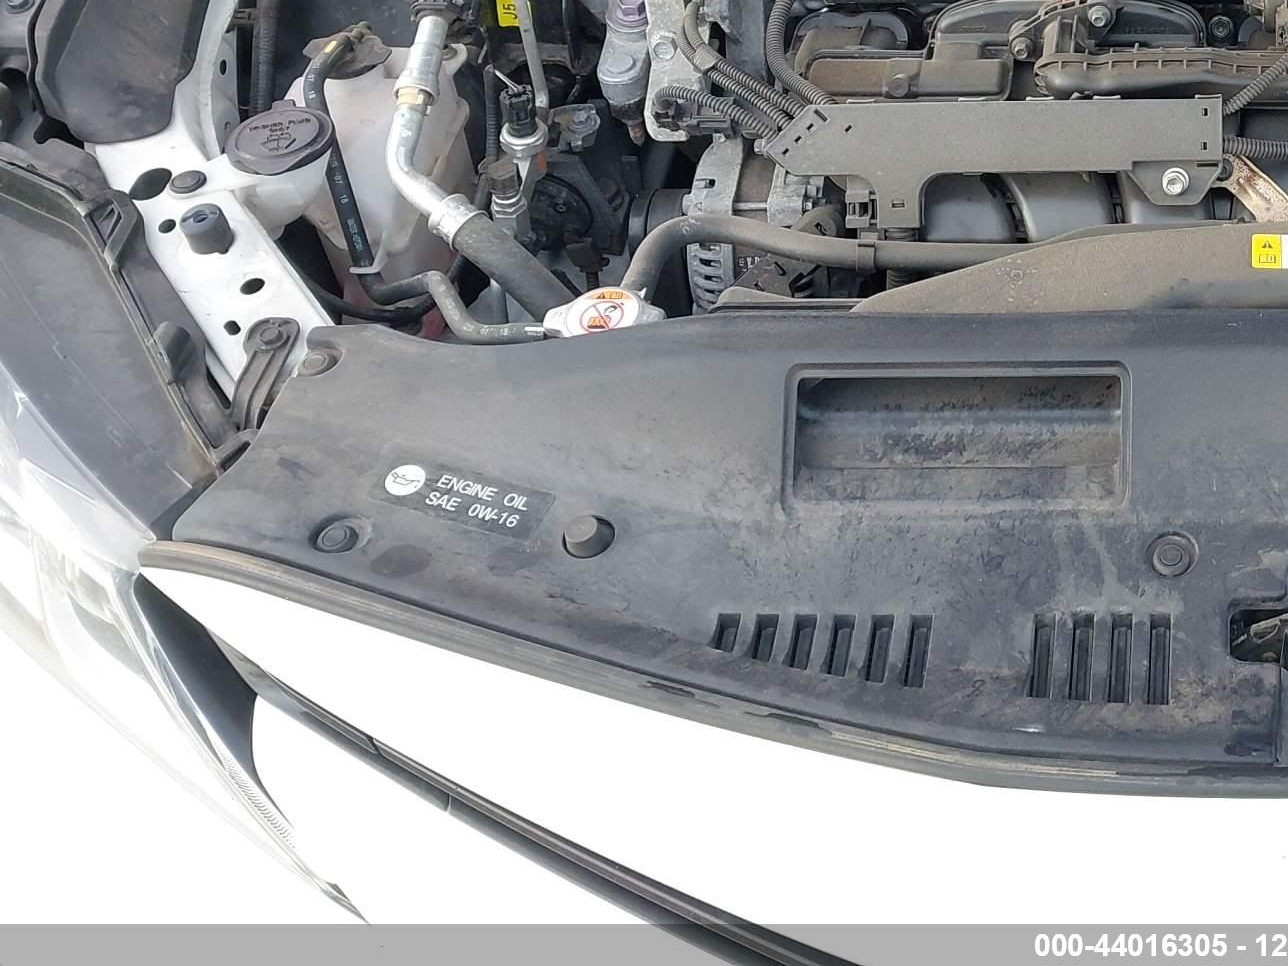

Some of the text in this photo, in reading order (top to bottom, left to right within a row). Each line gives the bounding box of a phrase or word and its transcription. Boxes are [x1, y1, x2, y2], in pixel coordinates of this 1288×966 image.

[425, 490, 520, 529] SAE 0W-16
[436, 474, 529, 511] ENGINE OIL
